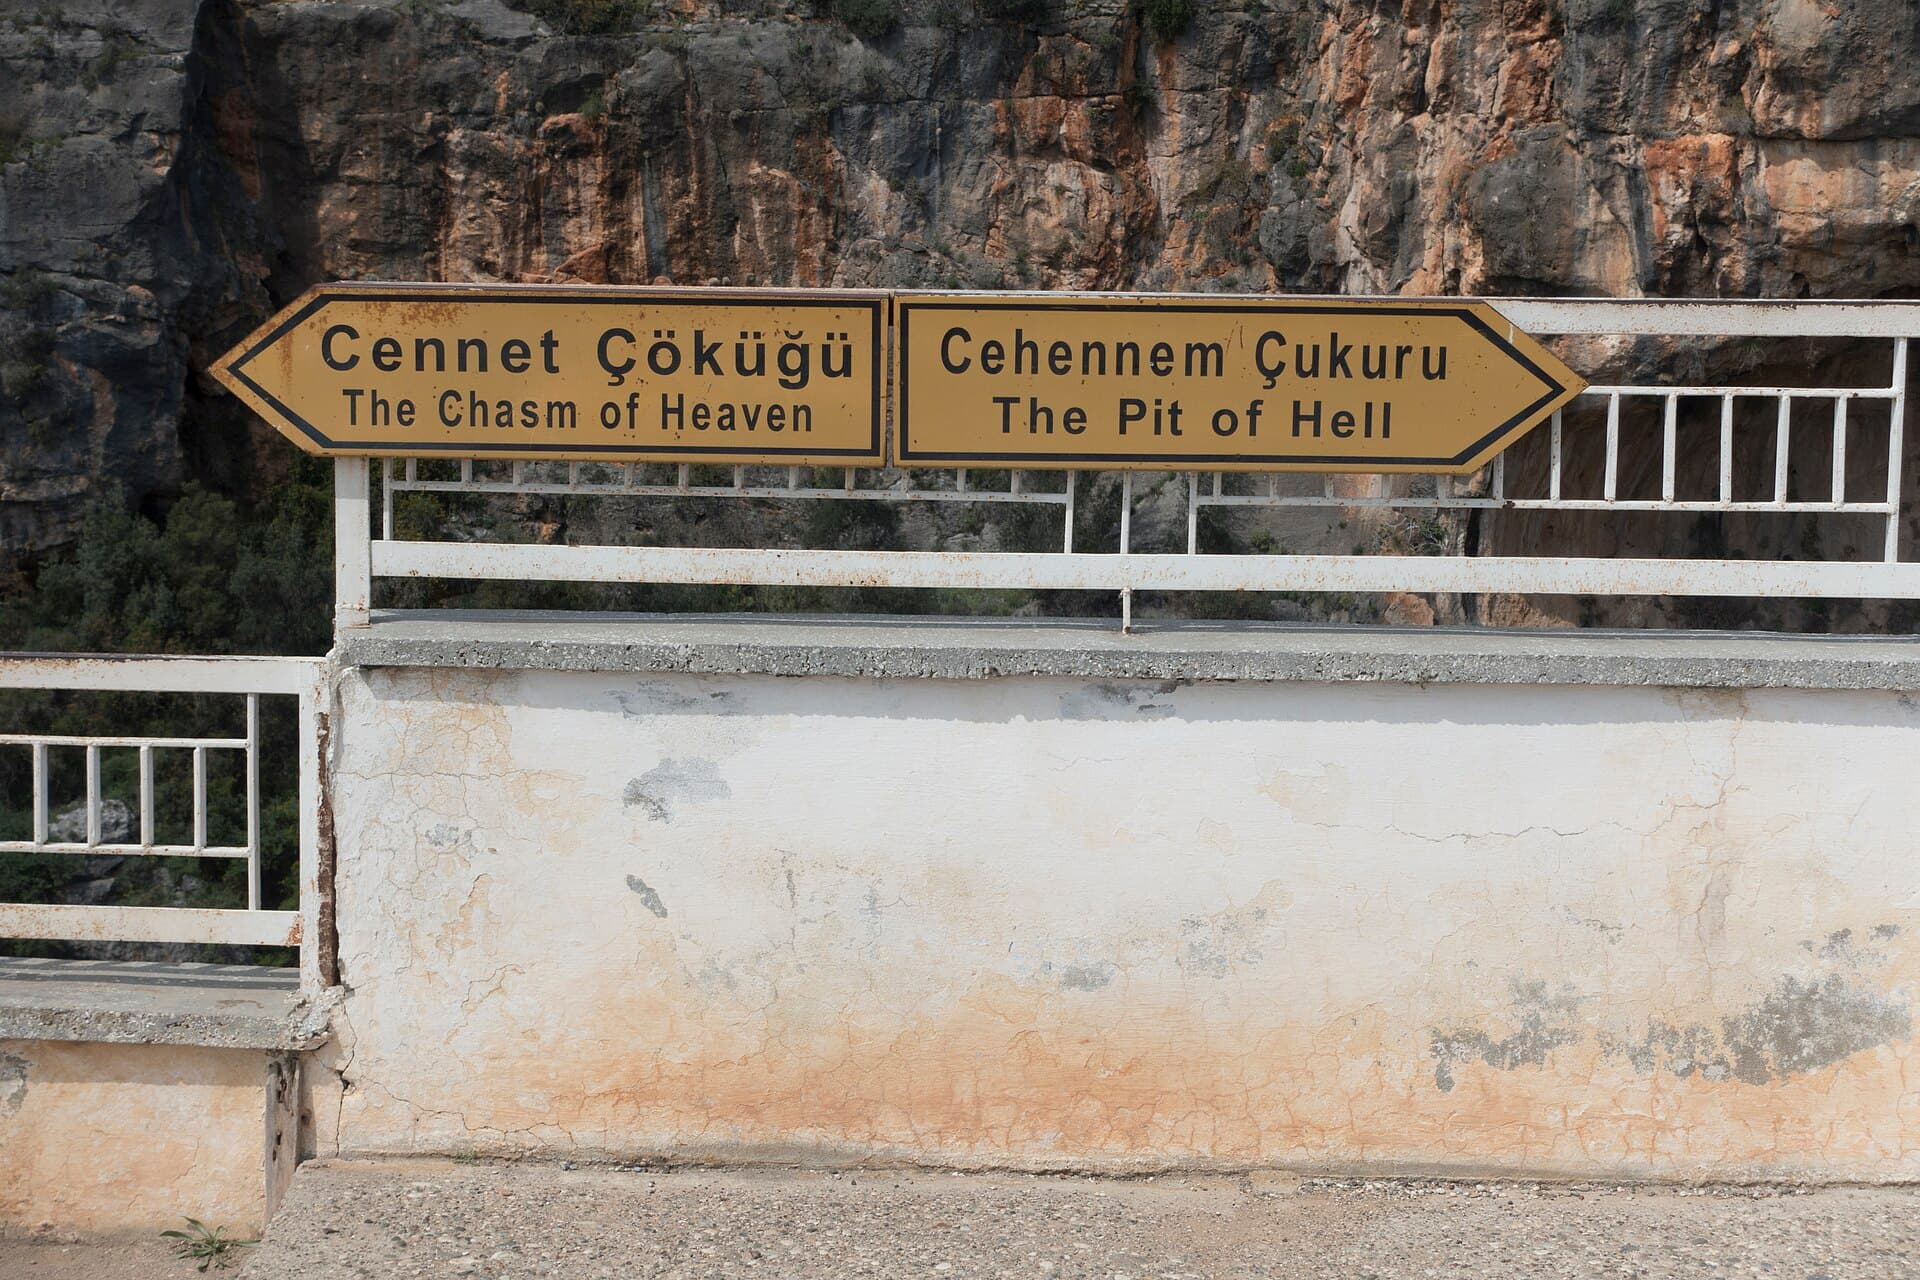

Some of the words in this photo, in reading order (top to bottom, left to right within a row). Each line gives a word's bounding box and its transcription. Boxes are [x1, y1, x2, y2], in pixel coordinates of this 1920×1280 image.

[321, 324, 560, 374] Cennet
[597, 328, 853, 390] Çöküğü
[941, 326, 1224, 377] Cehennem
[1255, 331, 1448, 390] Çukuru
[342, 388, 416, 427] The
[438, 389, 578, 429] Chasm
[600, 391, 640, 431] of
[661, 393, 813, 432] Heaven
[992, 396, 1088, 435] The
[1118, 398, 1184, 437] Pit
[1211, 399, 1265, 437] of
[1291, 400, 1392, 439] Hell
